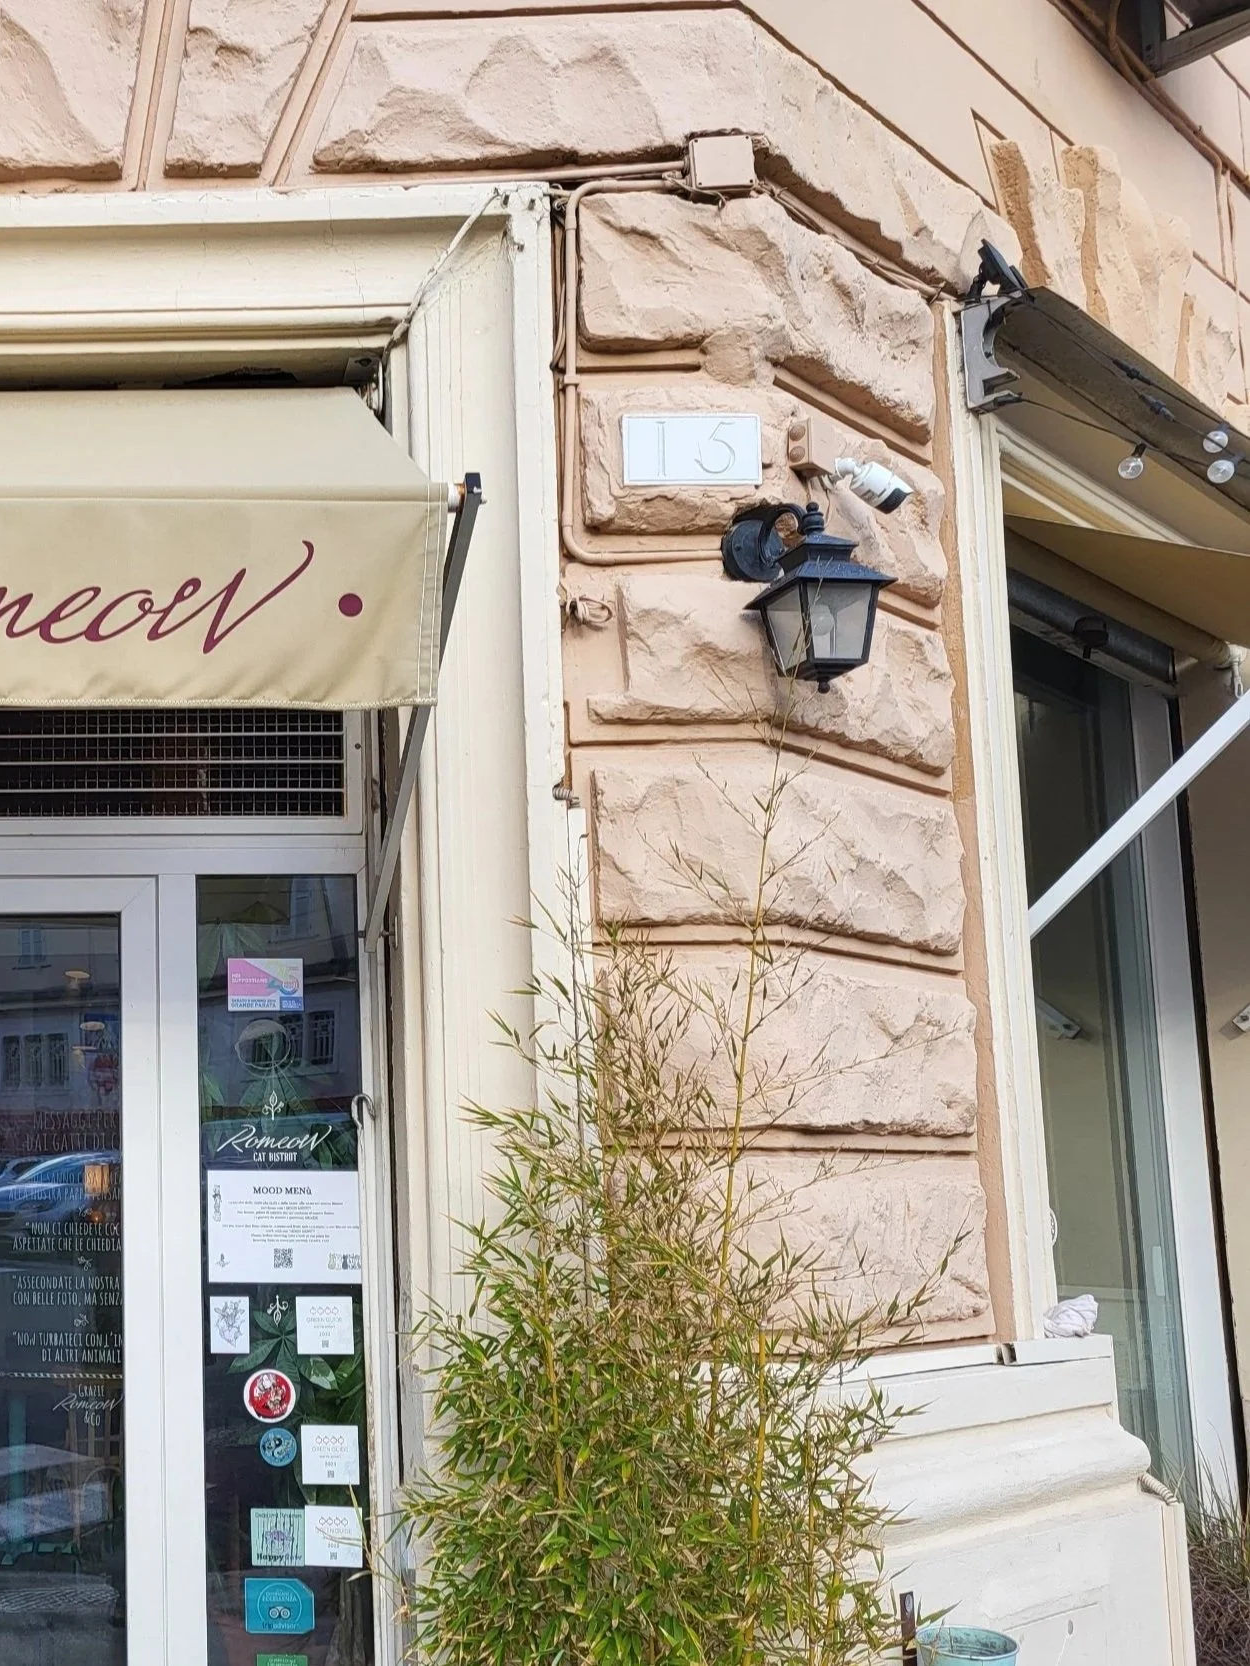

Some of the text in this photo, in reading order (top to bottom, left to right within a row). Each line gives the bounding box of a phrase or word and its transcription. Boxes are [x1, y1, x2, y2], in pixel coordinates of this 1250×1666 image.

[655, 420, 736, 478] 15
[33, 1111, 93, 1130] MESSAGGI
[52, 1133, 88, 1152] GATTI
[253, 1152, 298, 1162] CAT BISTROT
[253, 1186, 283, 1195] MOOD
[53, 1222, 62, 1236] CI
[64, 1222, 102, 1236] CHIEDETE
[13, 1237, 56, 1251] ASPETTATE
[58, 1237, 73, 1251] CHE
[75, 1237, 83, 1251] LE
[75, 1276, 86, 1290] LA
[88, 1276, 120, 1290] NOSTRA
[13, 1291, 30, 1305] CON
[32, 1291, 55, 1305] BELLE
[57, 1291, 82, 1307] FOTO,
[83, 1292, 98, 1305] MA
[39, 1332, 83, 1347] TURBATECI
[85, 1333, 102, 1347] CON
[41, 1349, 122, 1363] DI ALTRI ANIMALI
